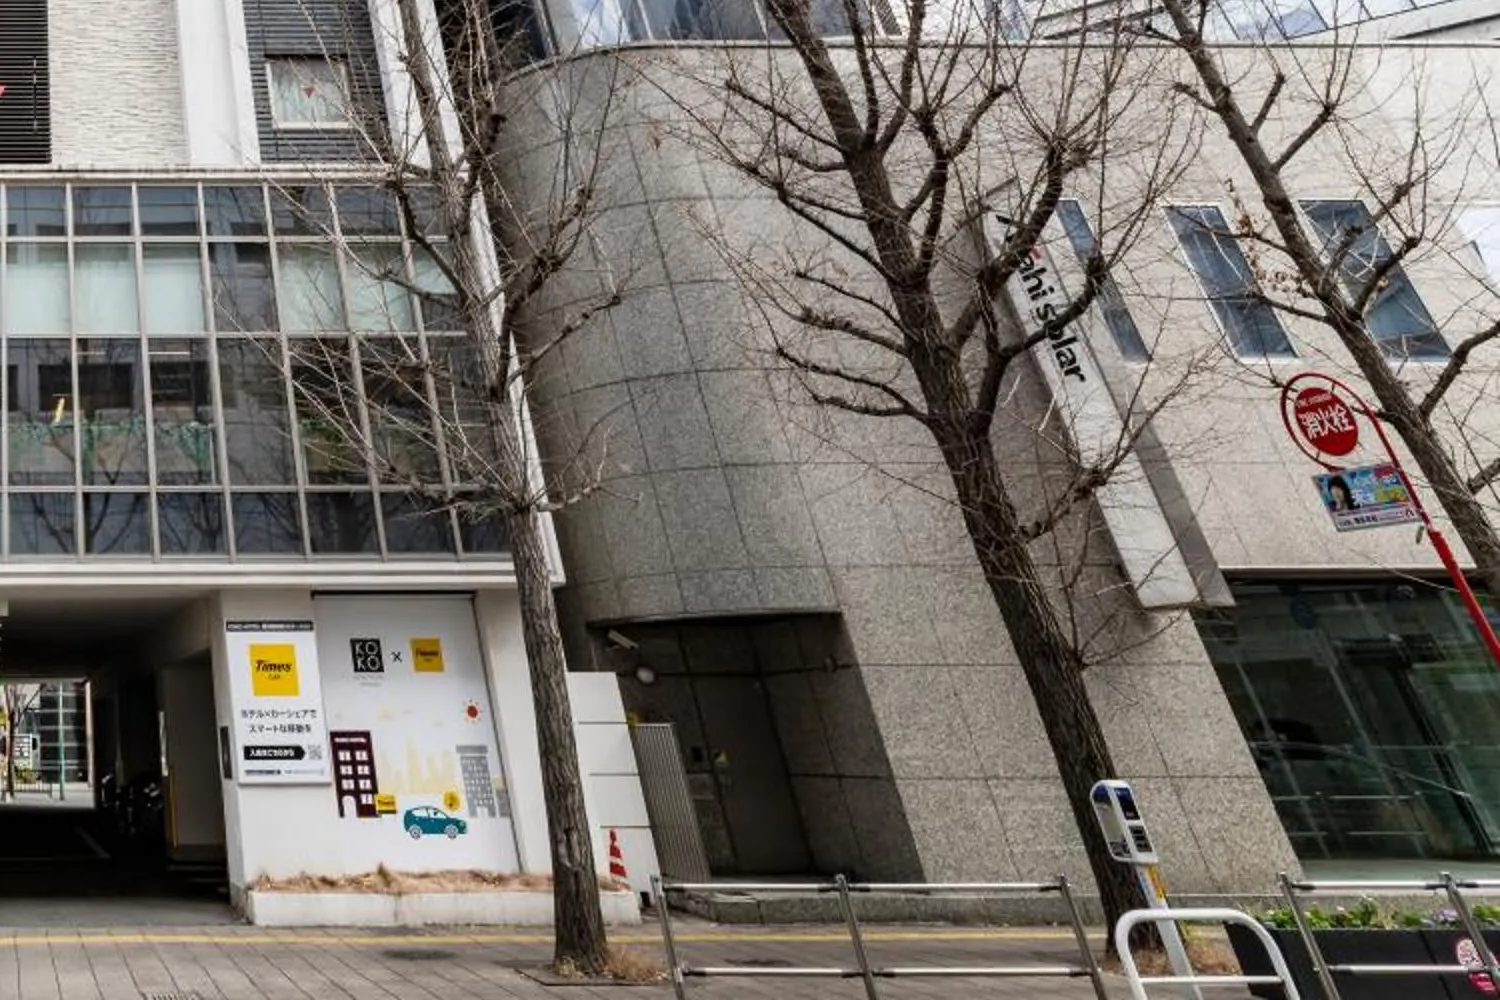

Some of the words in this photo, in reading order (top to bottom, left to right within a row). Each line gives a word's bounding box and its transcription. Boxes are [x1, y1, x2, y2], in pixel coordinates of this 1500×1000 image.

[1296, 403, 1355, 441] 消火栓
[255, 659, 292, 673] Times
